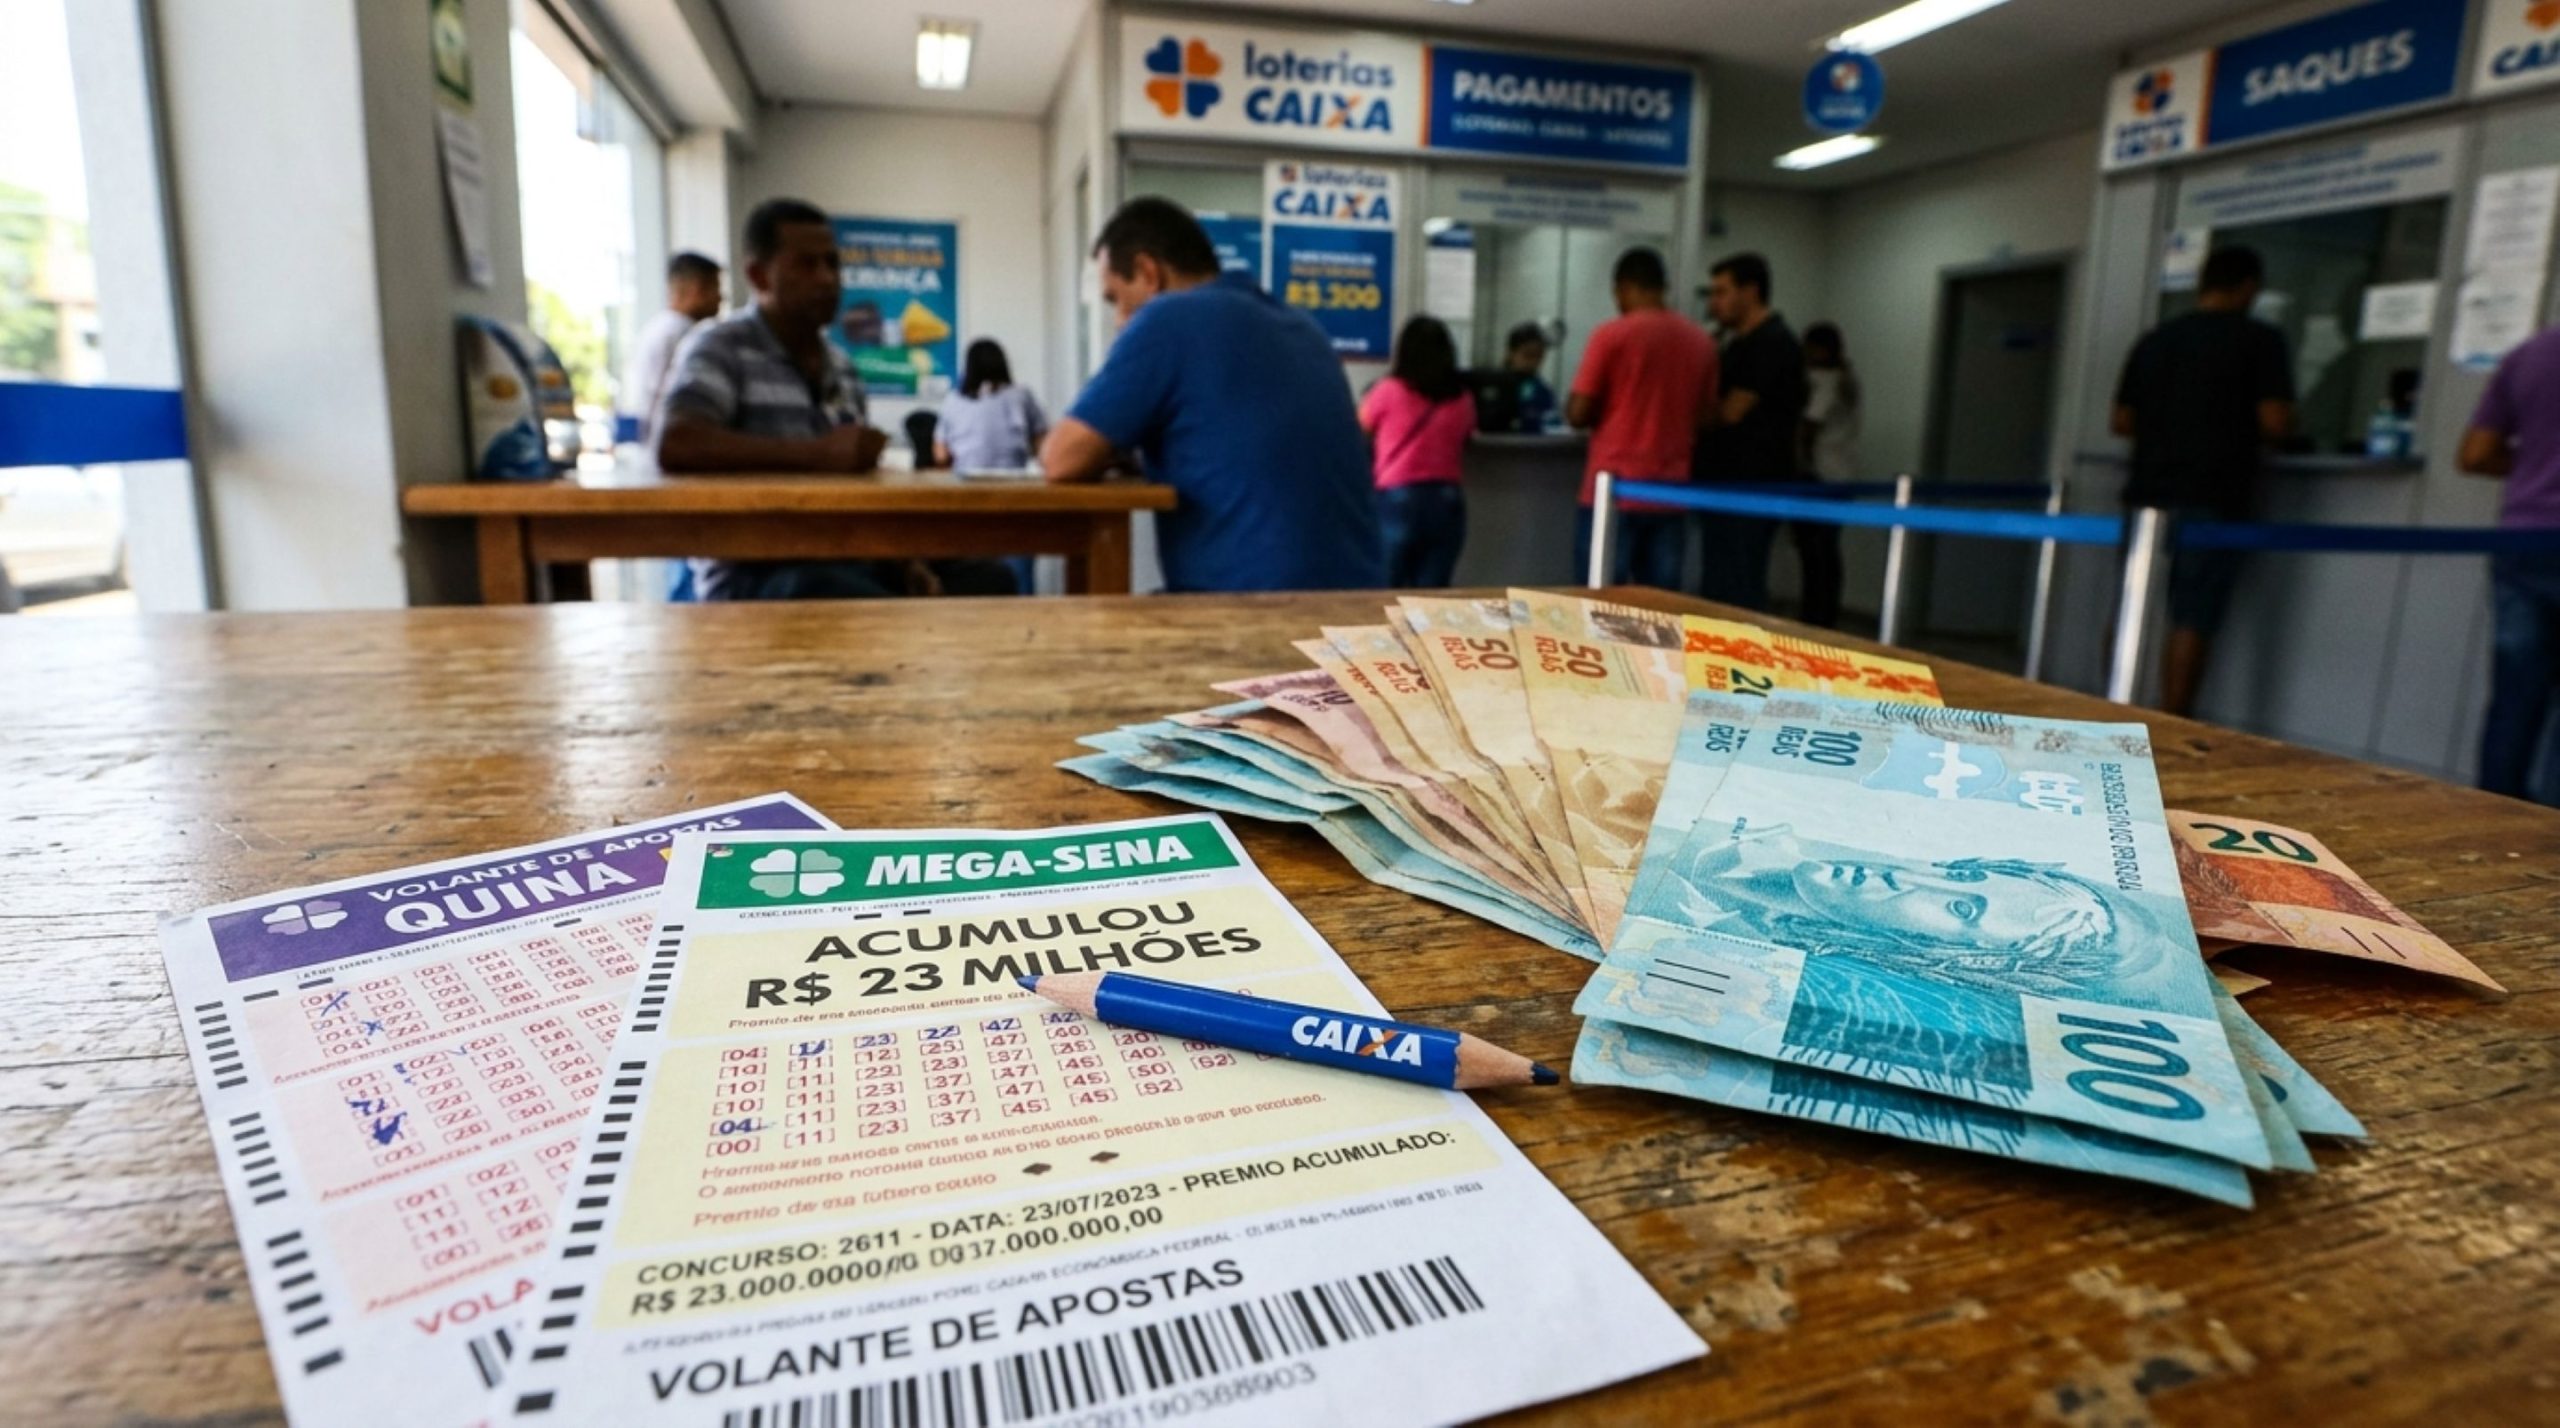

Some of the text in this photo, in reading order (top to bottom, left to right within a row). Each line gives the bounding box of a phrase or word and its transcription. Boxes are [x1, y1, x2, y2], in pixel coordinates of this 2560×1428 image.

[1244, 40, 1394, 88] loterias
[2241, 28, 2416, 106] SAQUES
[1244, 86, 1393, 132] CAIXA
[1453, 70, 1673, 120] PAGAMENTOS
[1273, 189, 1391, 222] CAIXA
[1466, 638, 1519, 670] 50
[1561, 642, 1608, 679] 50
[1804, 730, 1862, 766] 100
[864, 834, 1195, 887] MEGA-SENA
[2190, 823, 2318, 863] 20
[368, 857, 538, 901] VOLANTE
[548, 847, 594, 867] DE
[383, 862, 637, 934] QUINA
[804, 900, 1197, 962] ACUMULOU
[745, 971, 832, 1009] R$
[859, 961, 943, 995] 23
[962, 925, 1264, 986] MILHÕES
[1290, 1014, 1423, 1068] CAIXA
[2057, 1012, 2206, 1121] 100
[637, 1242, 828, 1285] CONCURSO:
[839, 1229, 900, 1256] 2611
[930, 1211, 1013, 1241] DATA:
[1022, 1183, 1161, 1224] 23/07/2023
[1183, 1160, 1285, 1192] PREMIO
[1292, 1130, 1456, 1173] ACUMULADO:
[414, 1278, 535, 1335] VOLA
[630, 1289, 676, 1317] R$
[649, 1323, 911, 1403] VOLANTE
[932, 1309, 1000, 1351] DE
[1016, 1257, 1246, 1334] APOSTAS
